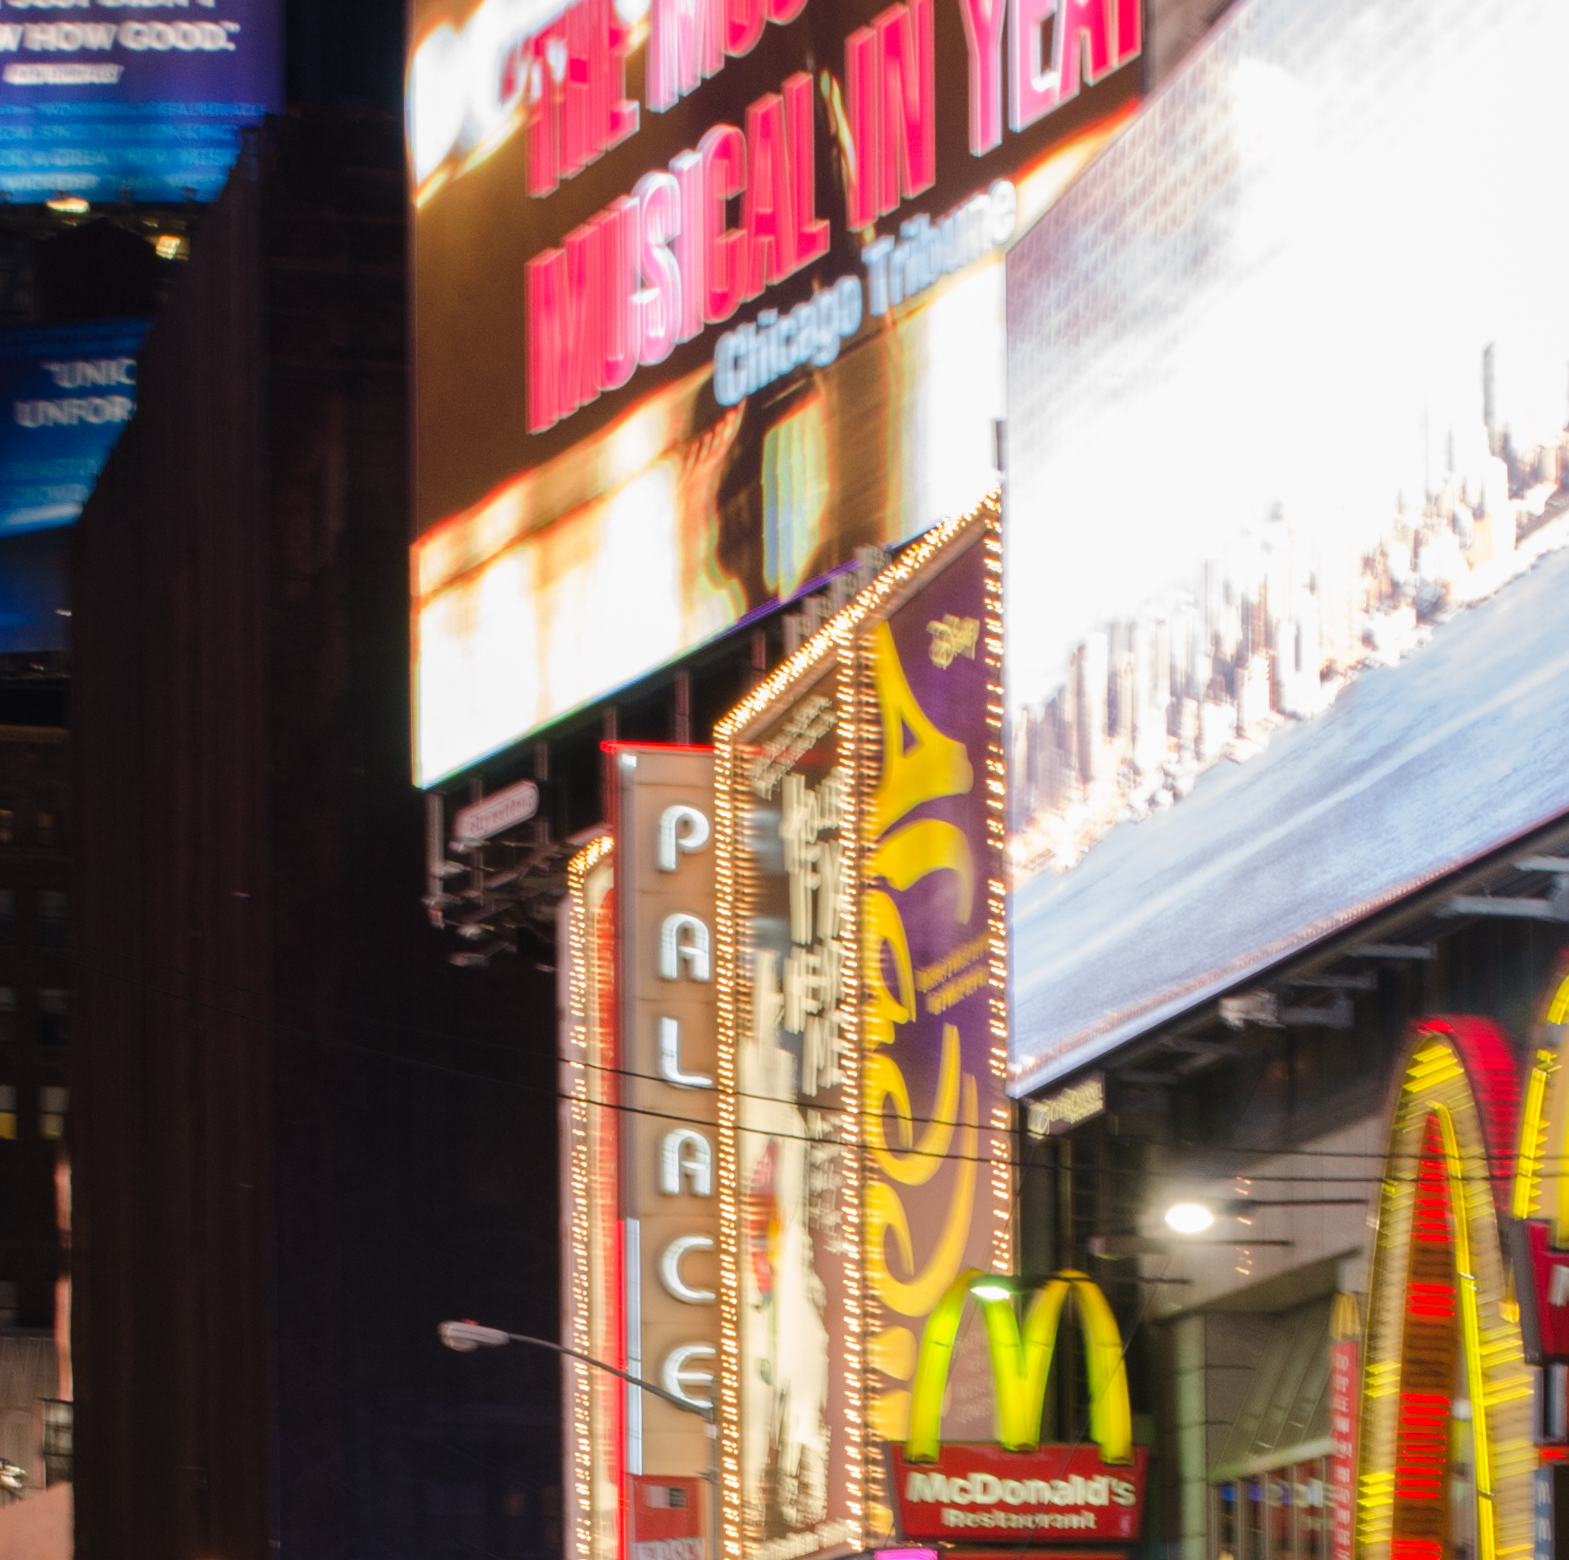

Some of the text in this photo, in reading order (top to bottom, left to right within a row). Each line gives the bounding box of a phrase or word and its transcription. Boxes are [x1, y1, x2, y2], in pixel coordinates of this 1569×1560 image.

[22, 22, 119, 51] HOW
[525, 70, 830, 435] MUSICAL
[844, 0, 935, 232] IN
[715, 179, 1018, 408] Chicago Tribune
[658, 803, 717, 1411] PALACE
[905, 1466, 1137, 1508] McDonald's
[940, 1506, 1098, 1530] Restaurant
